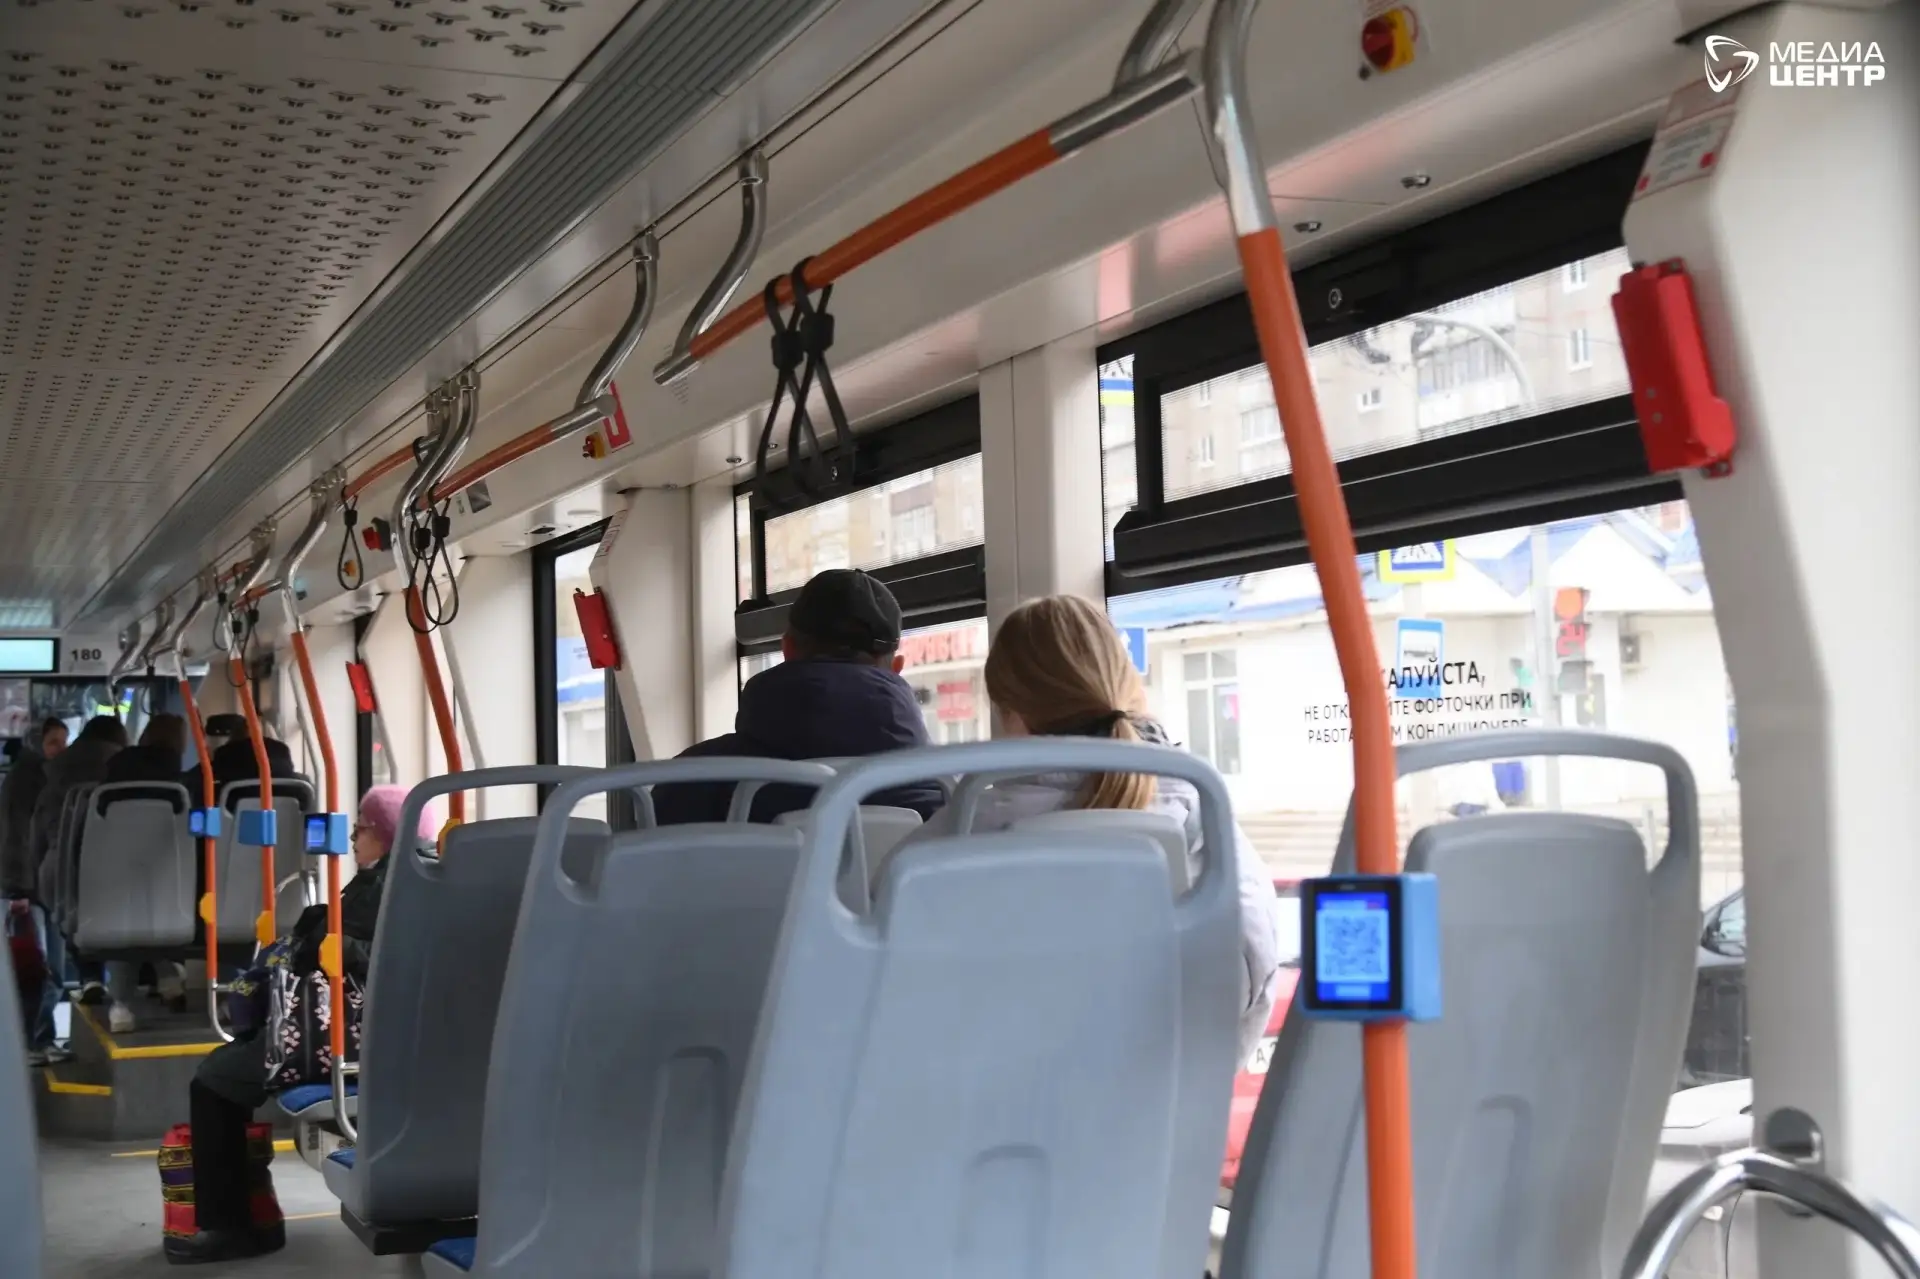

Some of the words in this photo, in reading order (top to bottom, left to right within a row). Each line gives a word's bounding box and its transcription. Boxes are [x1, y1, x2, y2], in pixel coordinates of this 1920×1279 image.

[71, 648, 102, 661] 180
[1382, 656, 1486, 689] АЛУЙСТА,
[1304, 704, 1319, 721] НЕ
[1414, 694, 1494, 714] ФОРТОЧКИ
[1500, 691, 1532, 710] ПРИ
